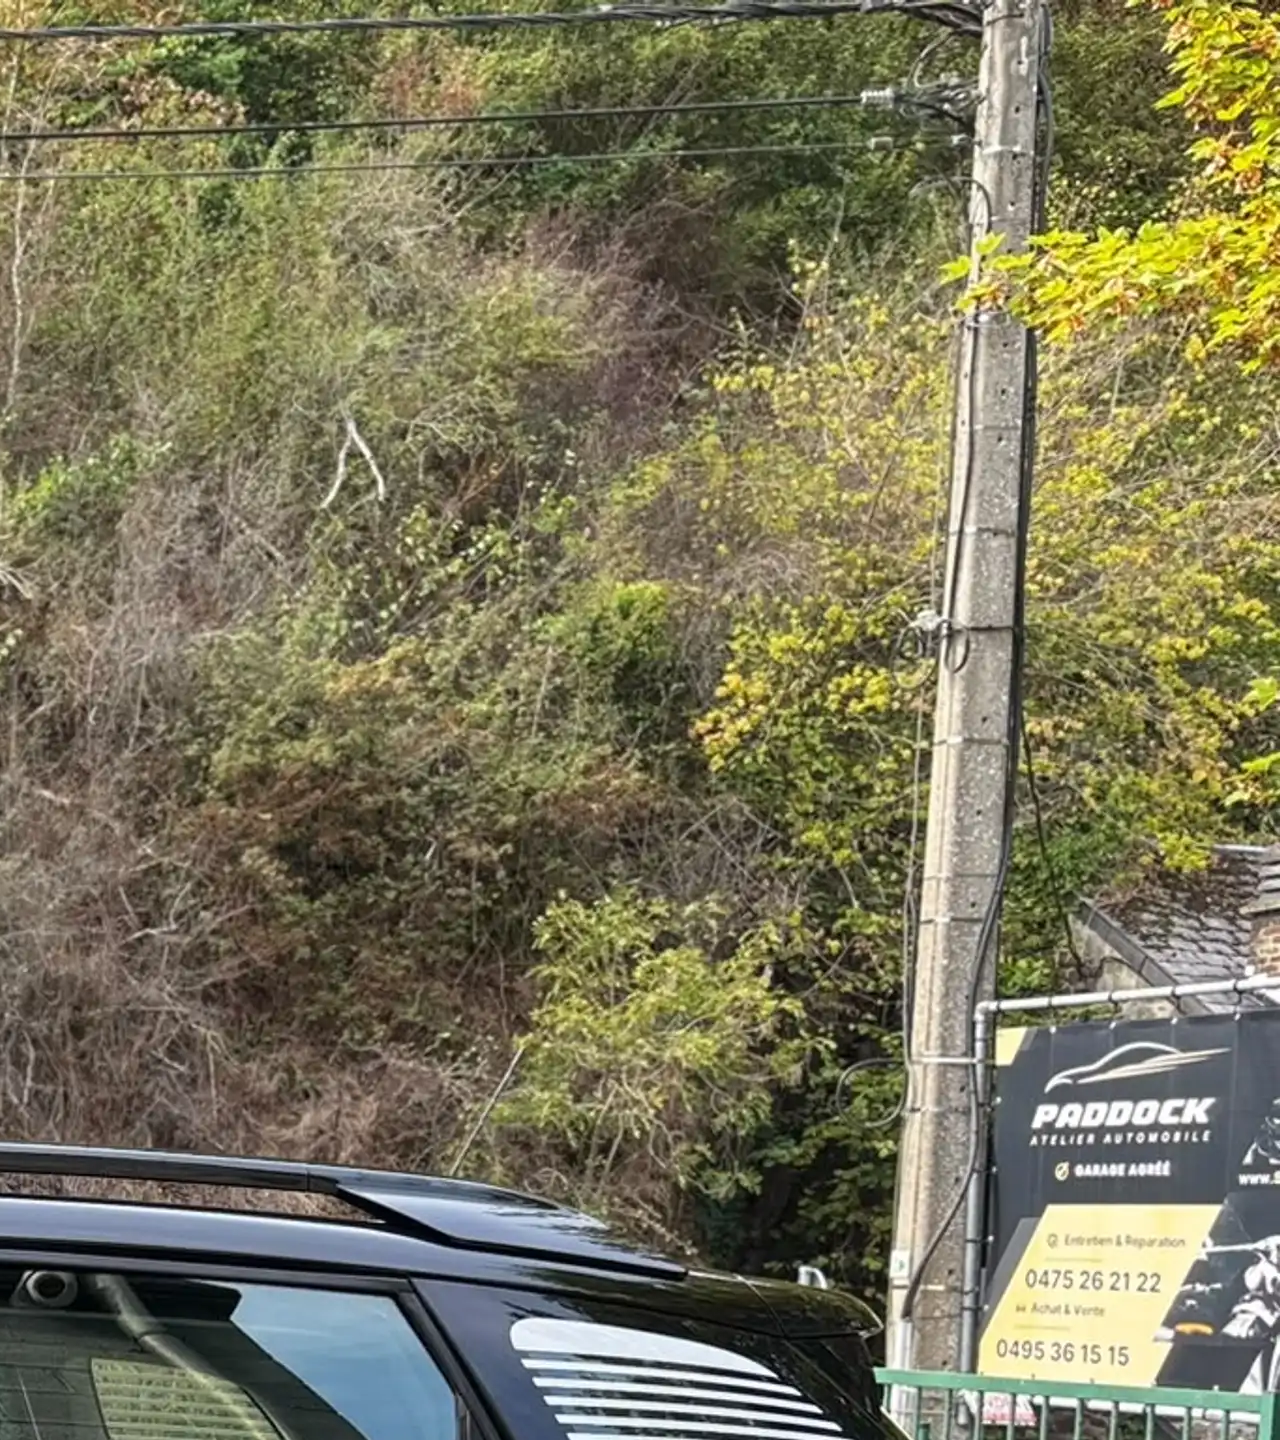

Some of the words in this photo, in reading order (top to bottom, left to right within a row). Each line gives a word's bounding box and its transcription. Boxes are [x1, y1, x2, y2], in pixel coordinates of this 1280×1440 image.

[1031, 1097, 1216, 1129] PADDOCK
[1029, 1133, 1095, 1147] ATELIER
[1102, 1130, 1211, 1145] AUTOMOBILE
[1074, 1162, 1126, 1177] GARAGE
[1025, 1269, 1074, 1290] 0475
[1079, 1271, 1104, 1291] 26
[1109, 1272, 1130, 1292] 21
[1136, 1272, 1161, 1294] 22
[996, 1339, 1045, 1360] 0495
[1050, 1342, 1075, 1363] 36
[1081, 1344, 1101, 1365] 15
[1108, 1346, 1130, 1367] 15
